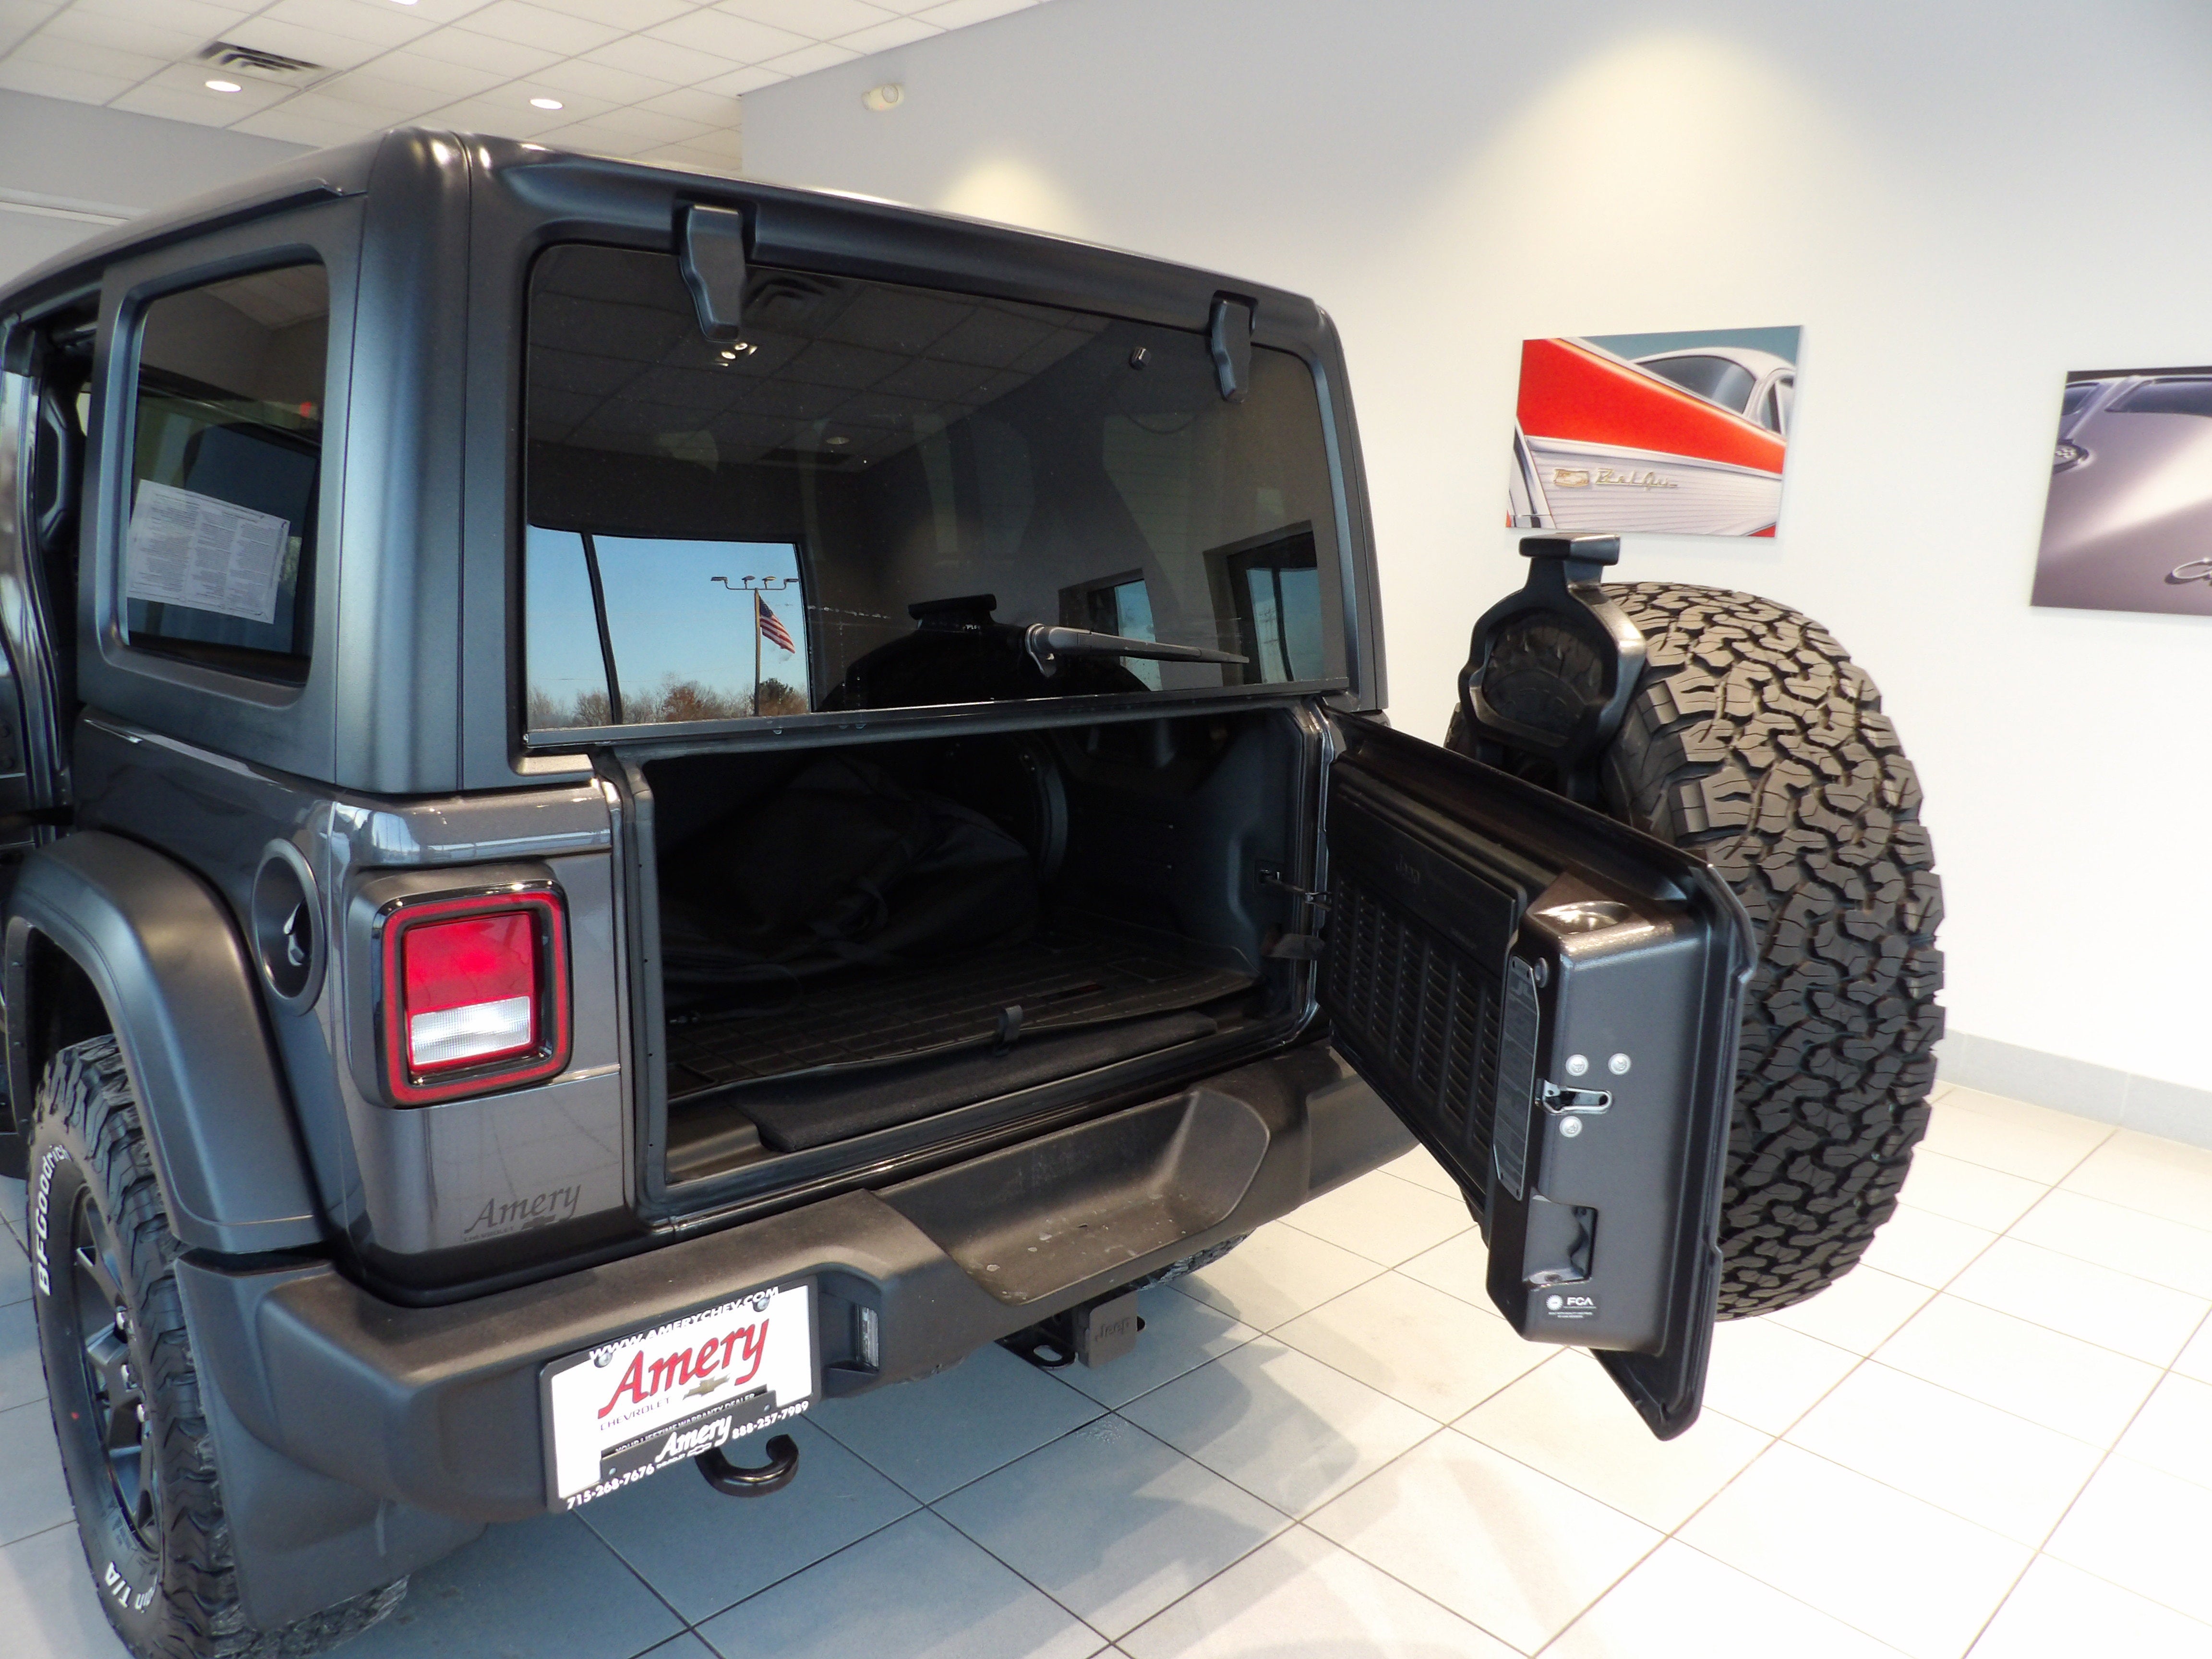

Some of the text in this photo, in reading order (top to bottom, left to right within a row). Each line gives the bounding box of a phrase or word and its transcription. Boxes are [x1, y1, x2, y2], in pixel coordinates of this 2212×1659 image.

[464, 1184, 581, 1234] Amery
[589, 1286, 780, 1361] WWW.AMERYCHEV.COM
[1567, 1297, 1594, 1306] FCA
[1095, 1317, 1131, 1342] Jeep
[598, 1318, 770, 1420] Amery
[601, 1396, 671, 1431] CHEVROLET
[732, 1400, 810, 1439] 888-257-7989
[654, 1415, 733, 1463] Amery
[566, 1463, 655, 1510] 715-268-7676
